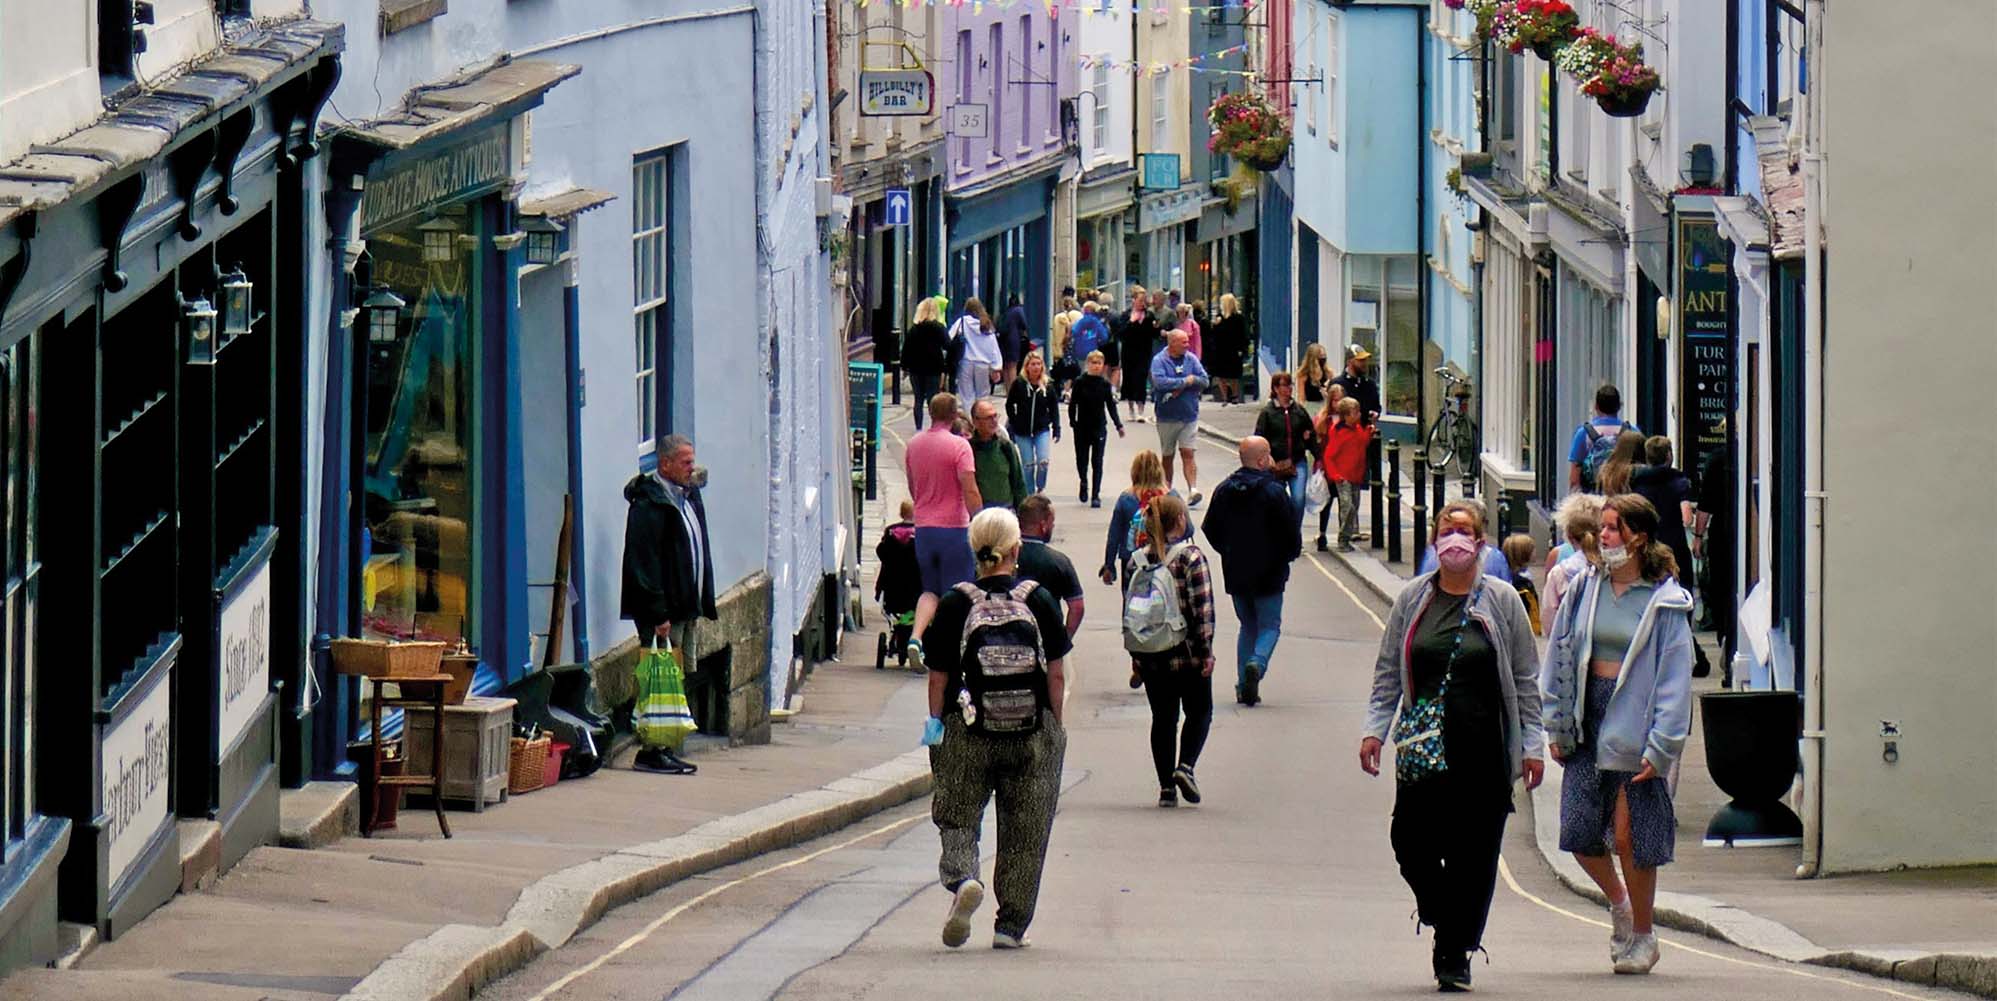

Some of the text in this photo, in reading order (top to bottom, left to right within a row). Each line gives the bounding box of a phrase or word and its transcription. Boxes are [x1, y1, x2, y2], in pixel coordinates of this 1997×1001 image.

[869, 80, 923, 101] HILLBILLY'S
[883, 95, 907, 106] BAR
[960, 114, 980, 128] 35
[362, 139, 506, 226] LUDGATE HOUSE ANTIQUES
[1685, 290, 1727, 312] ANT
[1695, 345, 1725, 359] FUR
[225, 632, 247, 712] Since
